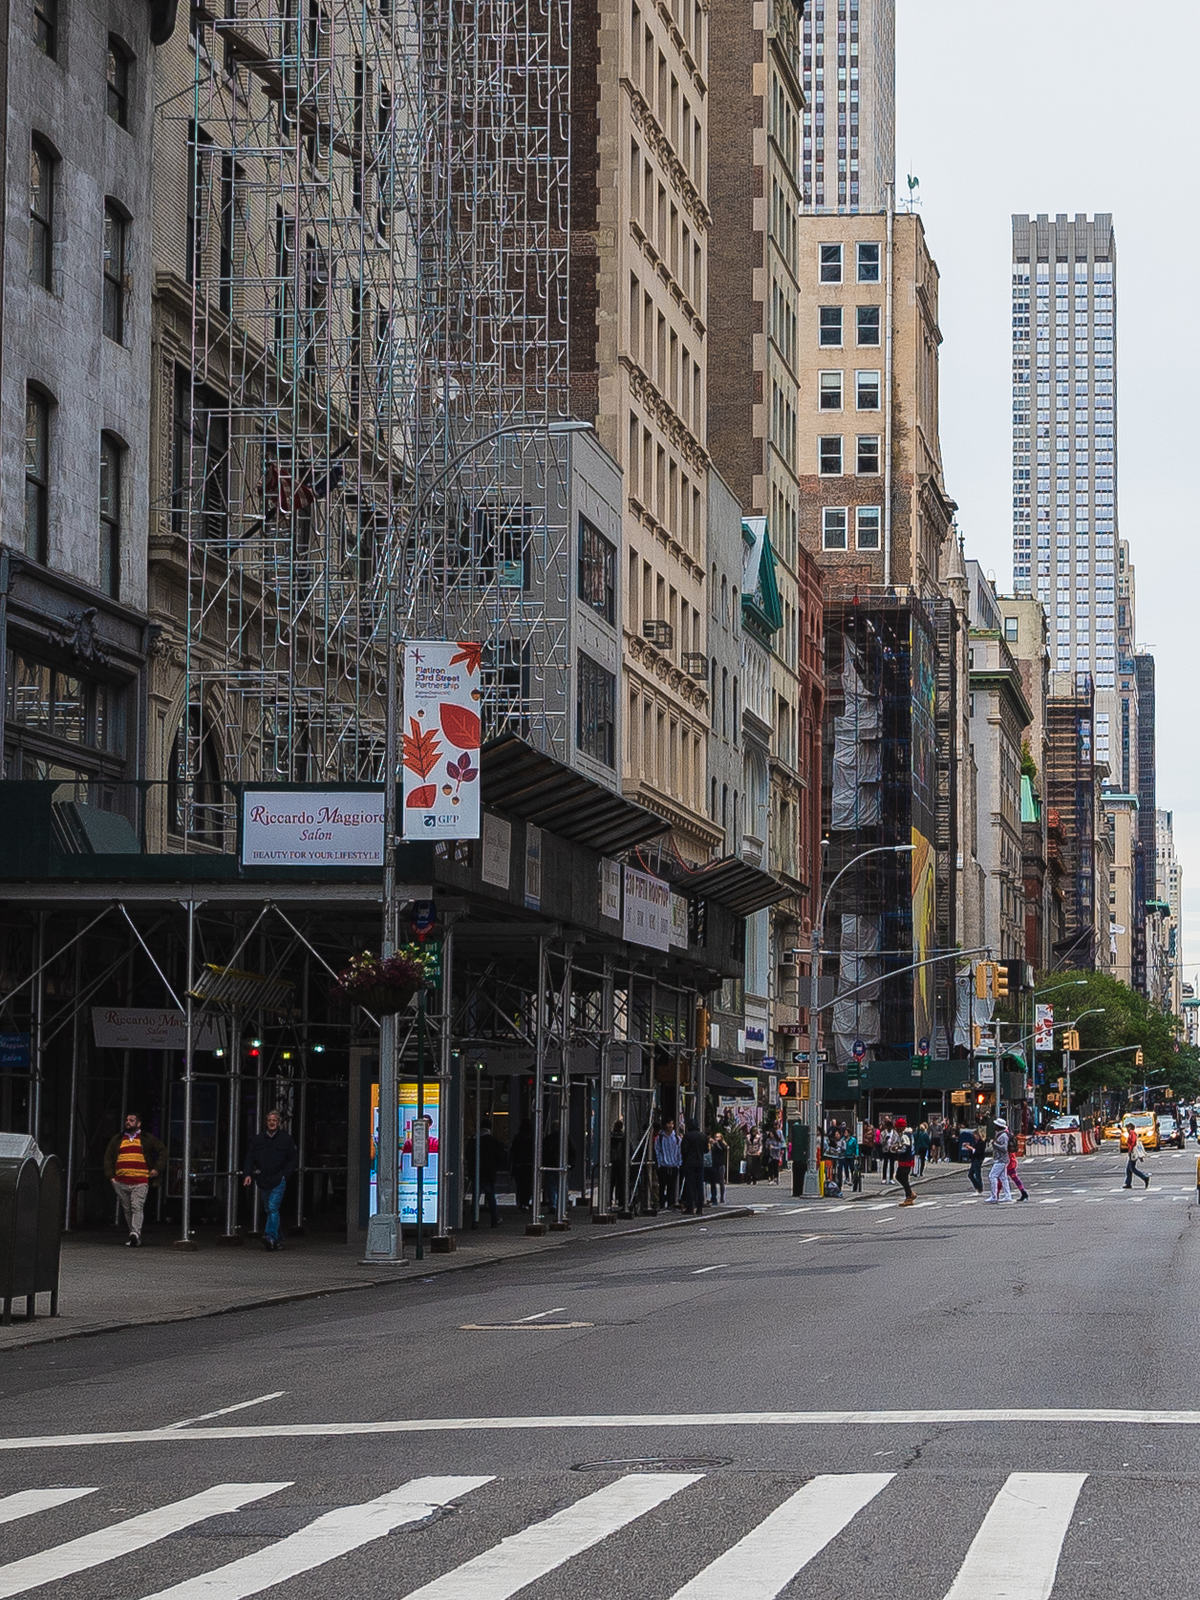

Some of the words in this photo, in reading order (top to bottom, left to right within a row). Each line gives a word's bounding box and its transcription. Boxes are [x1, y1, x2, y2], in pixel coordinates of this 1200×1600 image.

[415, 674, 434, 682] 23rd
[436, 674, 460, 682] Street
[415, 681, 460, 691] Partnership
[250, 805, 315, 826] Riccardo
[300, 828, 332, 841] Salon
[253, 851, 288, 860] BEAUTY
[289, 851, 307, 859] FOR
[308, 851, 333, 860] YOUR
[334, 851, 380, 861] LIFESTYLE
[105, 1010, 156, 1027] Riccardo
